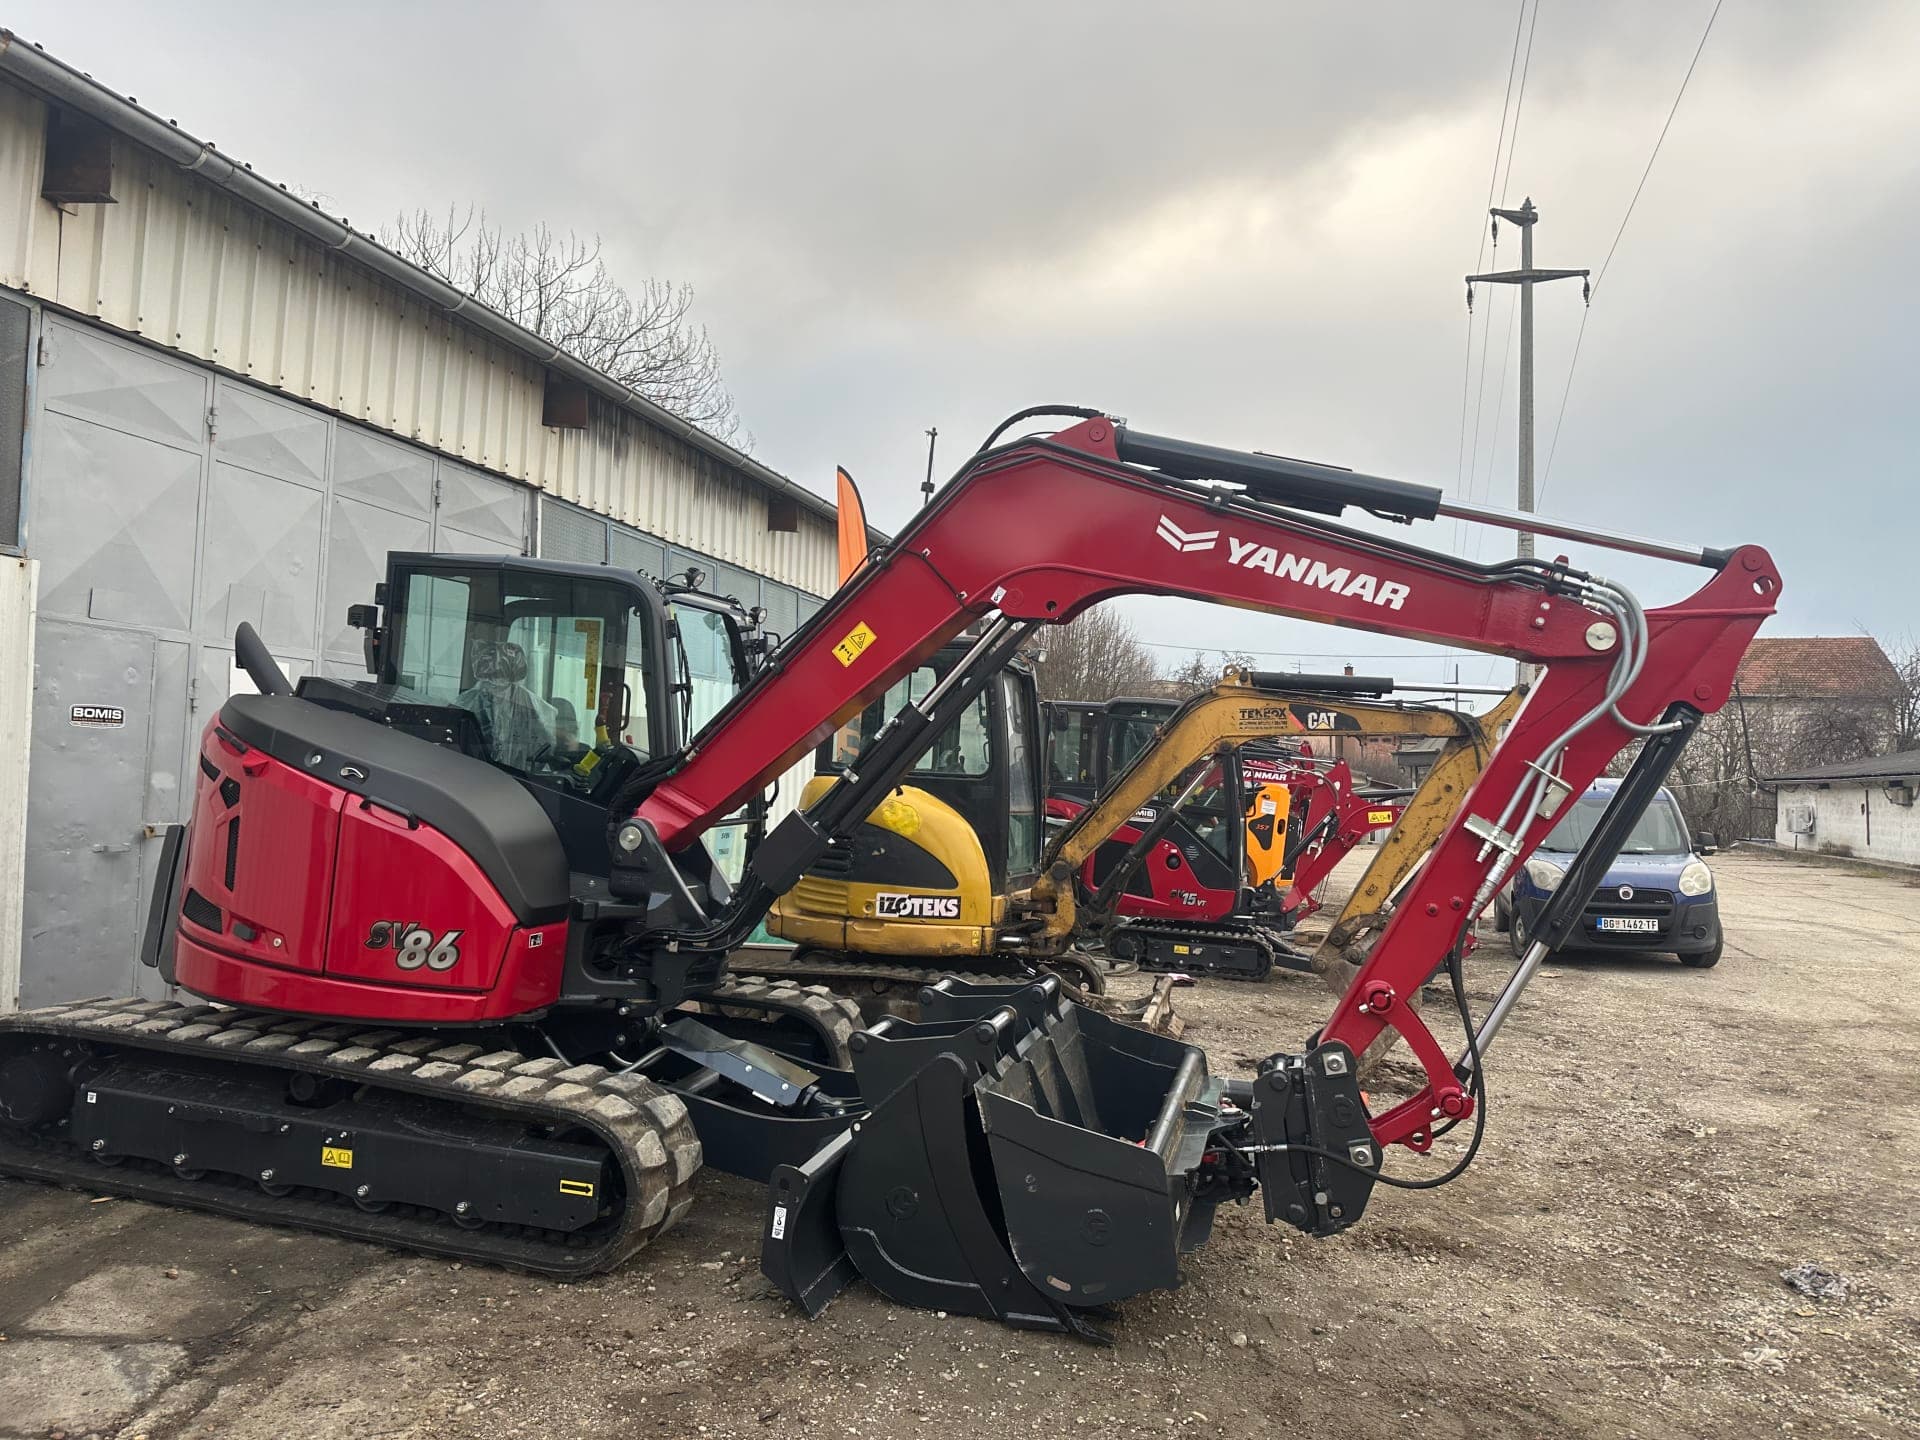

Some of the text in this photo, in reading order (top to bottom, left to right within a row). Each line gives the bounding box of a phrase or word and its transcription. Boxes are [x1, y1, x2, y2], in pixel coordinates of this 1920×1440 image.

[1228, 536, 1411, 611] YANMAR
[73, 707, 122, 720] BOMIS
[1307, 712, 1337, 730] CAT
[1242, 769, 1287, 781] YANMAR
[879, 896, 959, 917] IZOTEKS
[1603, 919, 1615, 929] BG
